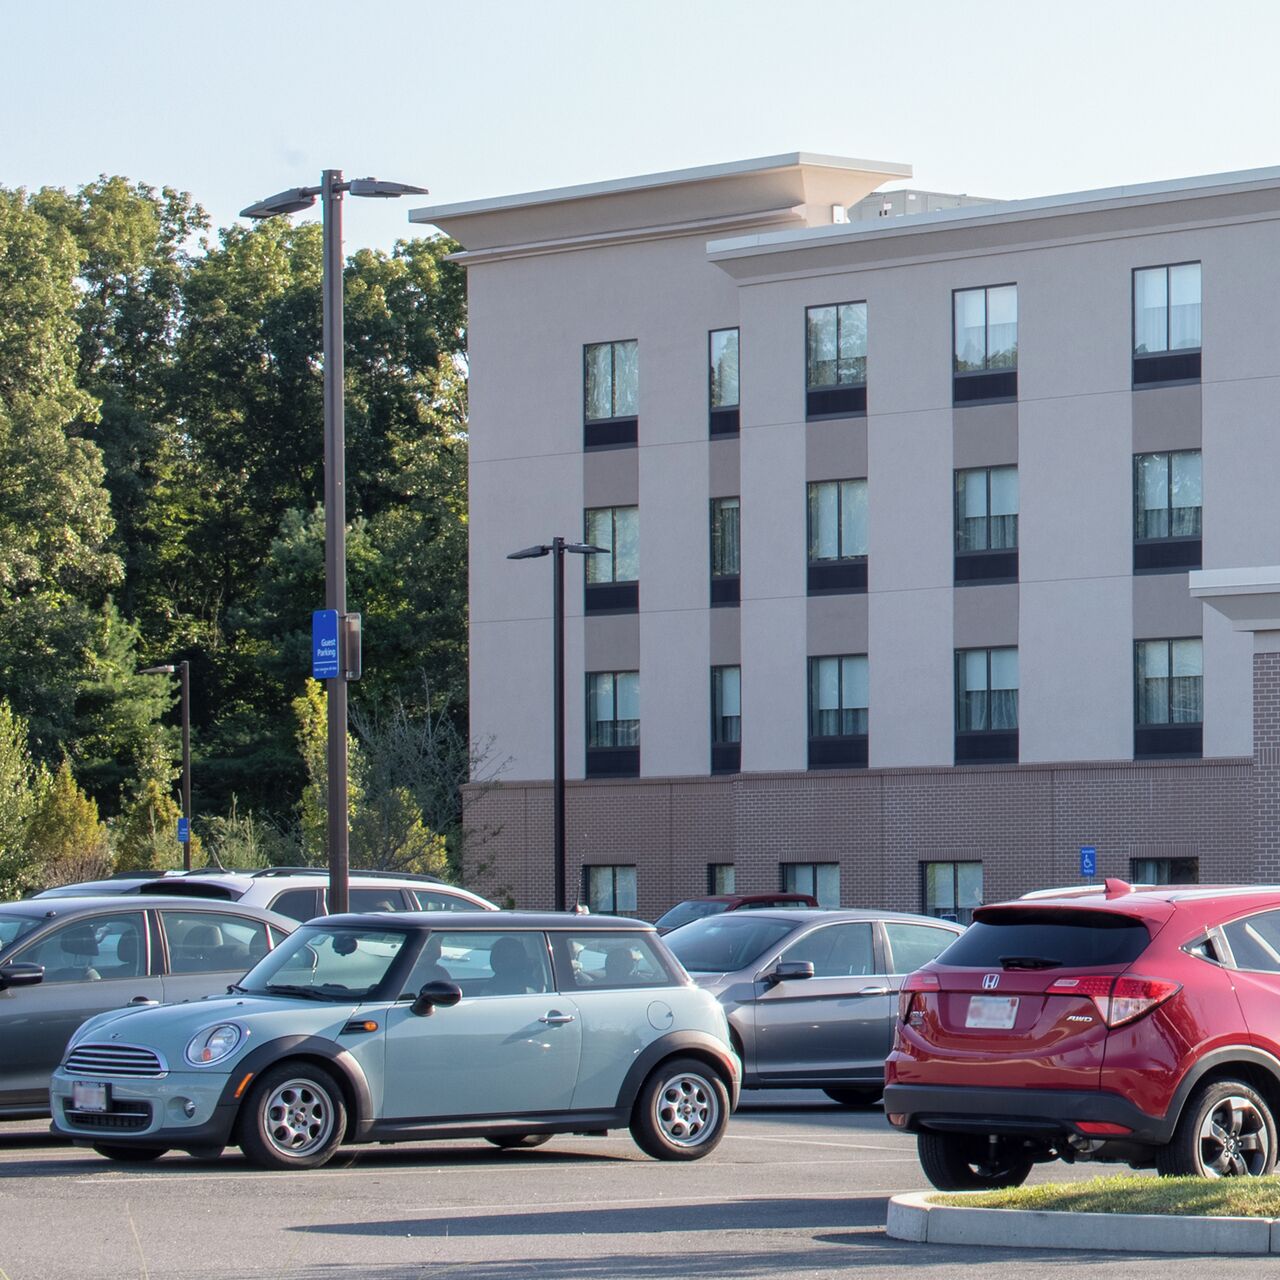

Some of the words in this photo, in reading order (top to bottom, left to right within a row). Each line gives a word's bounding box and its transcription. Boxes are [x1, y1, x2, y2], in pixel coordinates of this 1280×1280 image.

[320, 638, 336, 647] Guest
[317, 648, 336, 658] Parking
[1066, 1015, 1093, 1023] AWD
